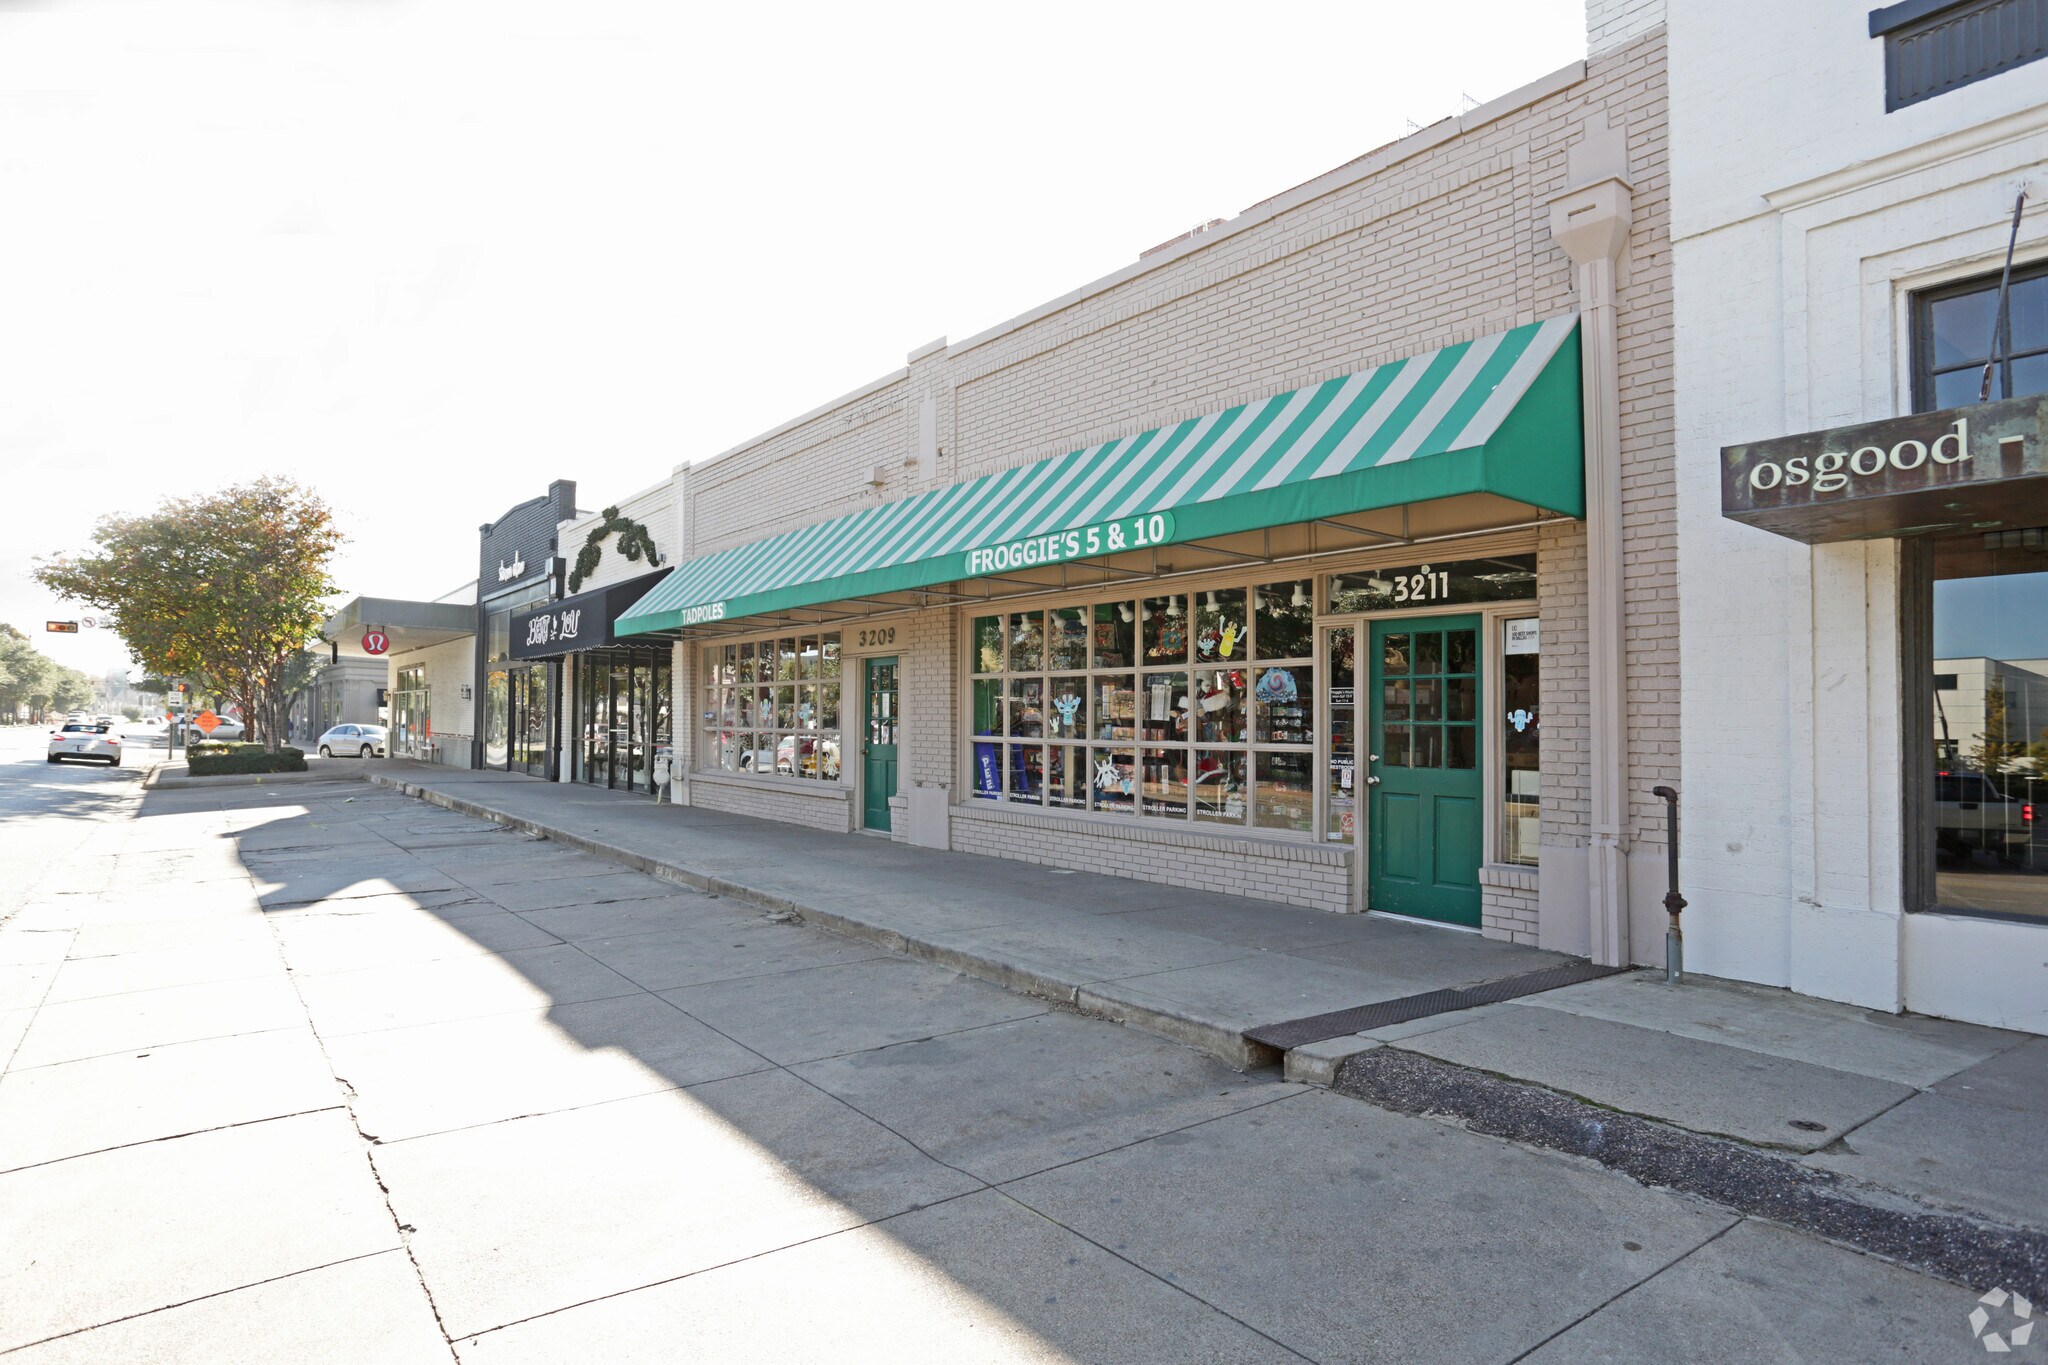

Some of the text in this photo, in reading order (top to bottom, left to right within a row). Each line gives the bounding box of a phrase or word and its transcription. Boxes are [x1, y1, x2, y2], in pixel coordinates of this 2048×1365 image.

[1749, 417, 1974, 493] osgood
[970, 515, 1165, 574] FROGGIE'S 5 & 10
[1394, 571, 1448, 602] 3211
[681, 601, 724, 625] TADPOLES
[859, 626, 896, 647] 3209
[1142, 804, 1187, 814] STROLLER PARKING
[1196, 809, 1222, 817] STROLLER
